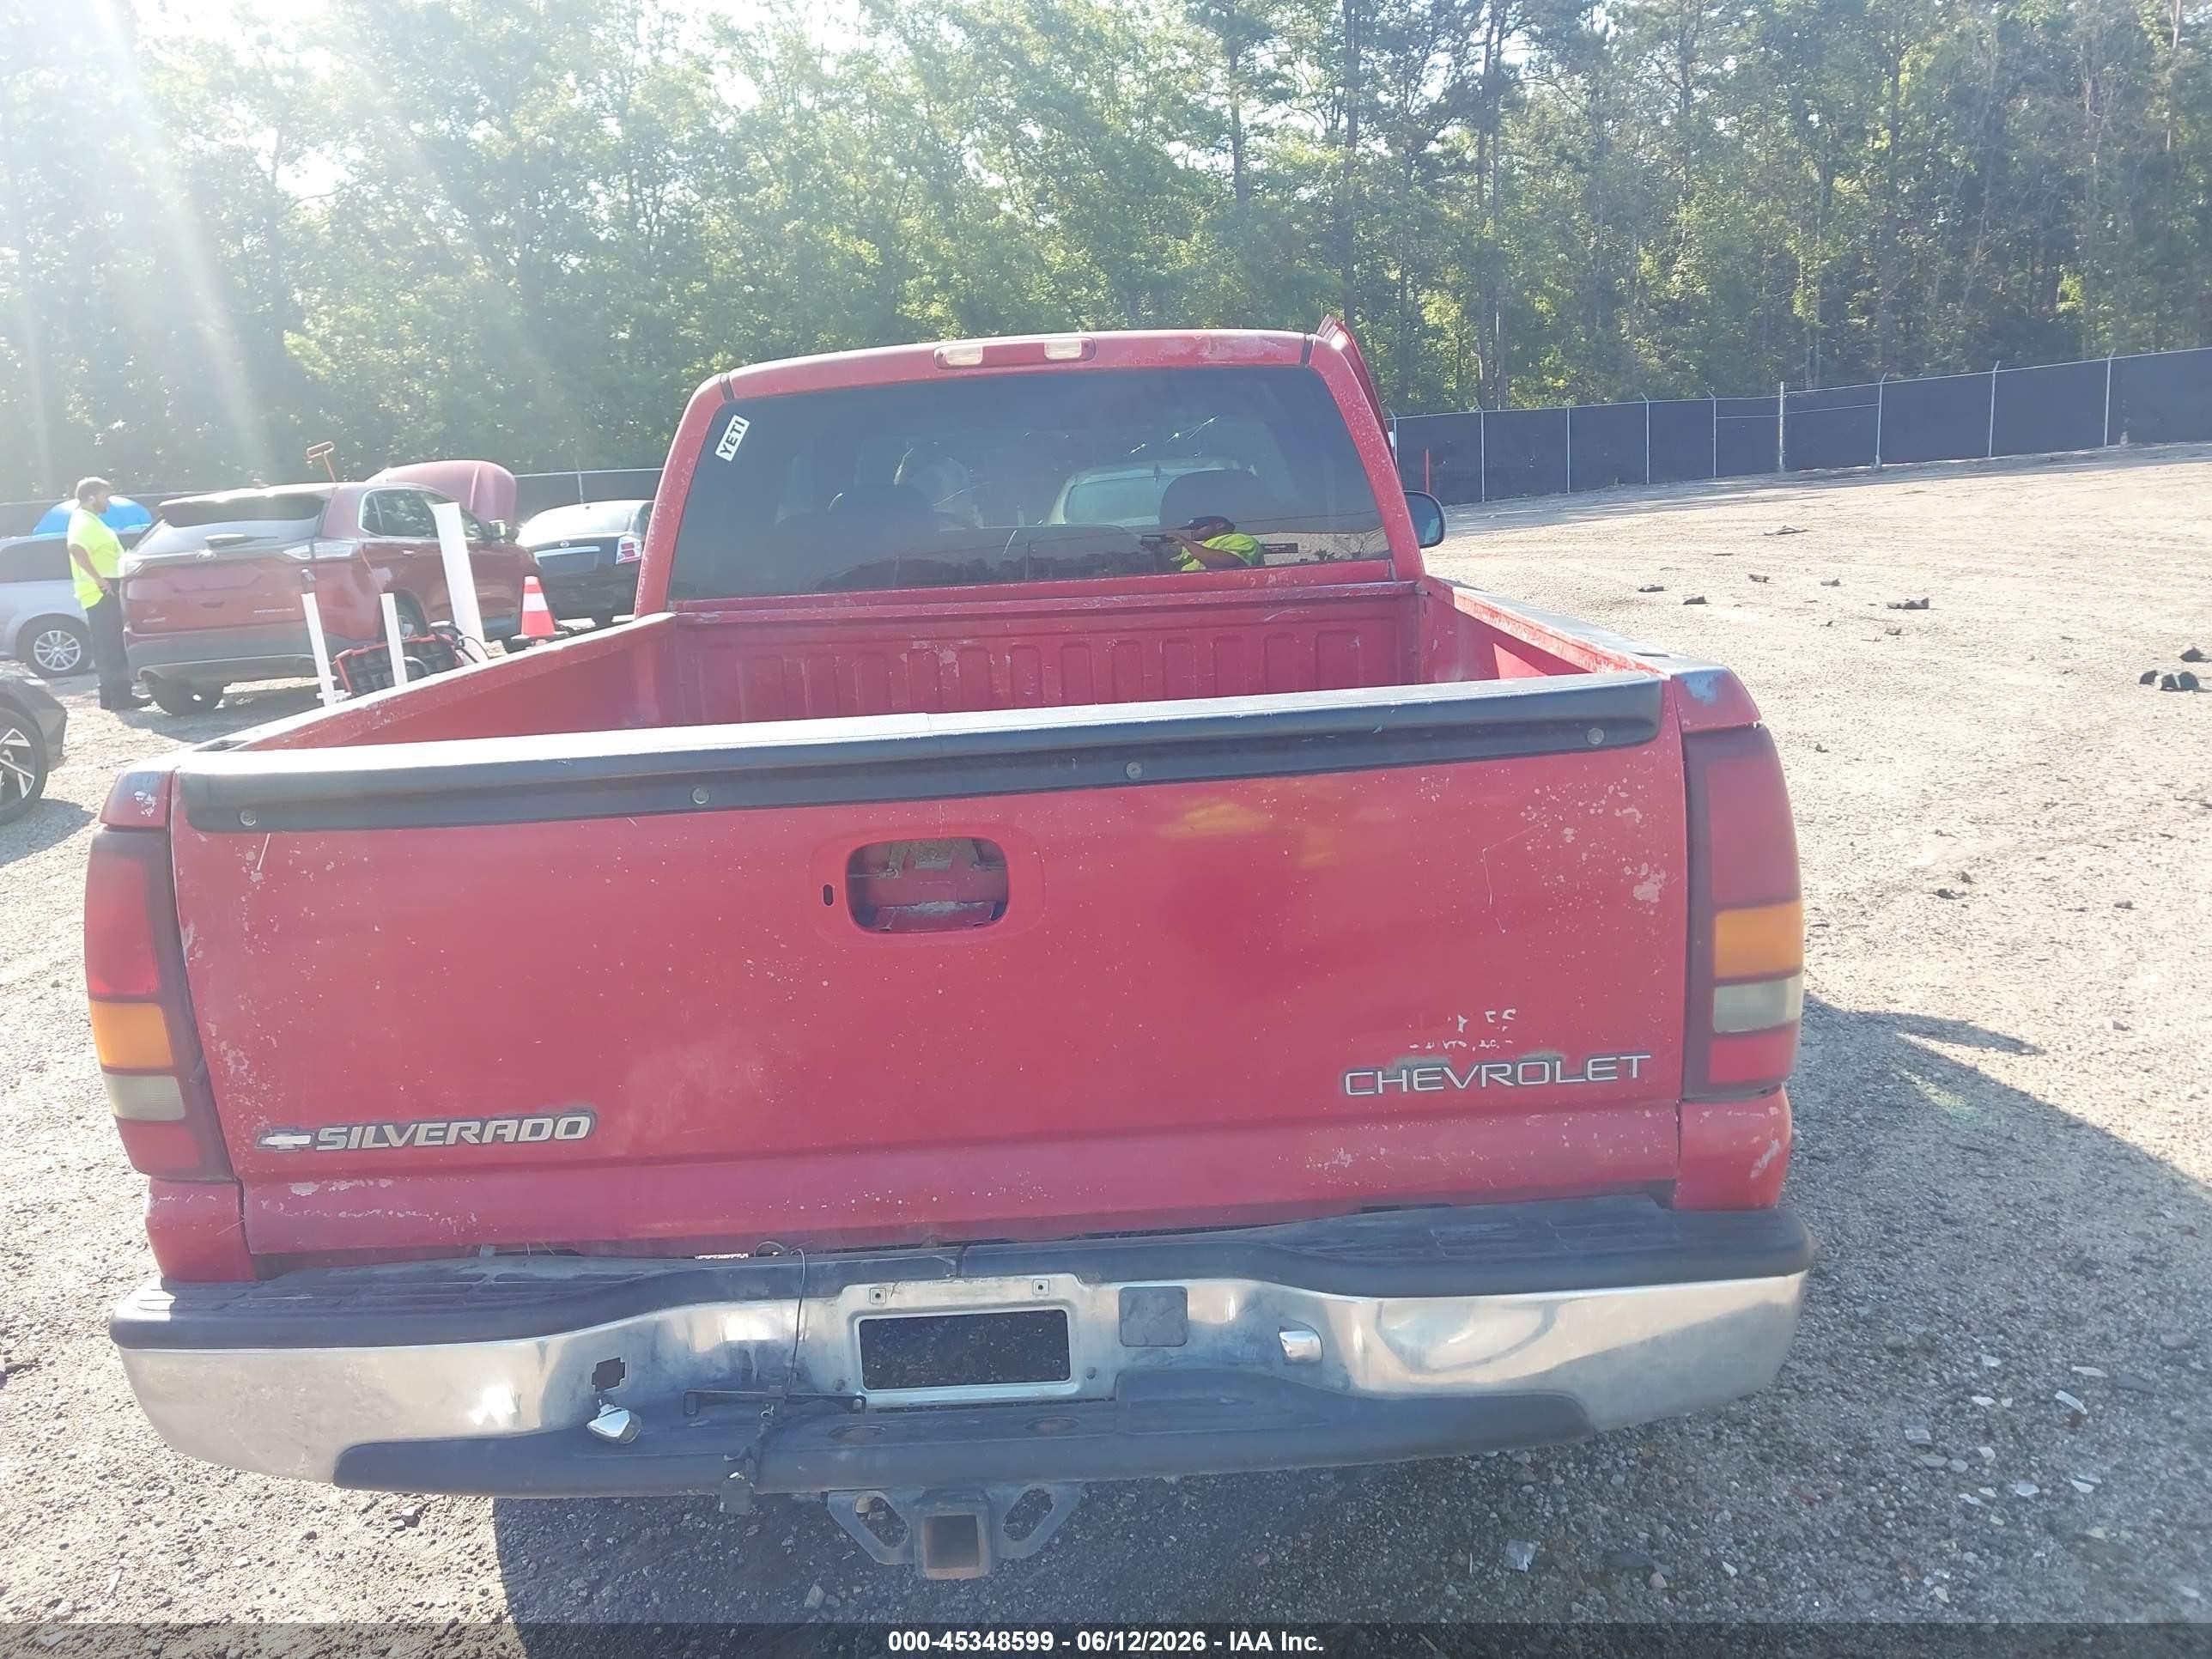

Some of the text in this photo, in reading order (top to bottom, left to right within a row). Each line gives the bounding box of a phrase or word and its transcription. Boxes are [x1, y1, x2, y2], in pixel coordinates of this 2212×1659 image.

[720, 419, 746, 455] YETI
[1344, 1054, 1652, 1097] CHEVROLET
[315, 1115, 591, 1152] SILVERADO
